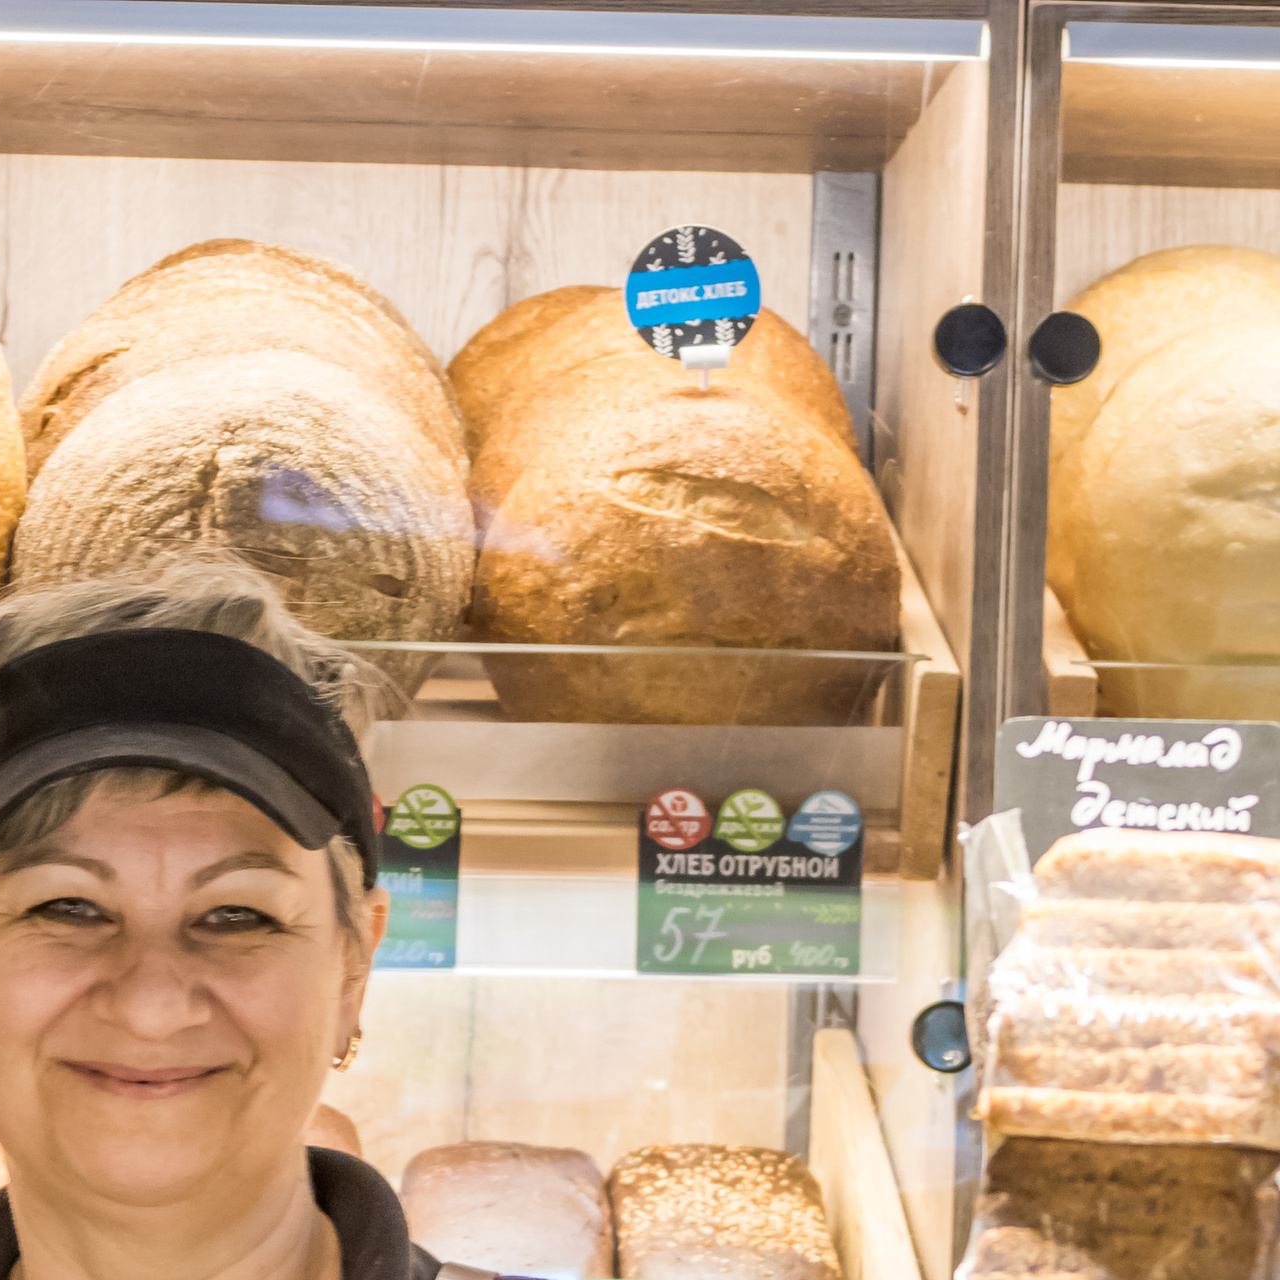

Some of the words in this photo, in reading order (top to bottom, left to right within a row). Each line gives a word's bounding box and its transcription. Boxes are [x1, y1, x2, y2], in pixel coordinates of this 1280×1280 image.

[636, 286, 701, 309] ДЕТОКС
[702, 281, 747, 300] ХЛЕБ
[655, 853, 715, 877] ХЛЕБ
[719, 852, 840, 879] ОТРУБНОЙ
[653, 903, 728, 965] 57
[732, 945, 772, 970] руб
[789, 940, 835, 966] 400
